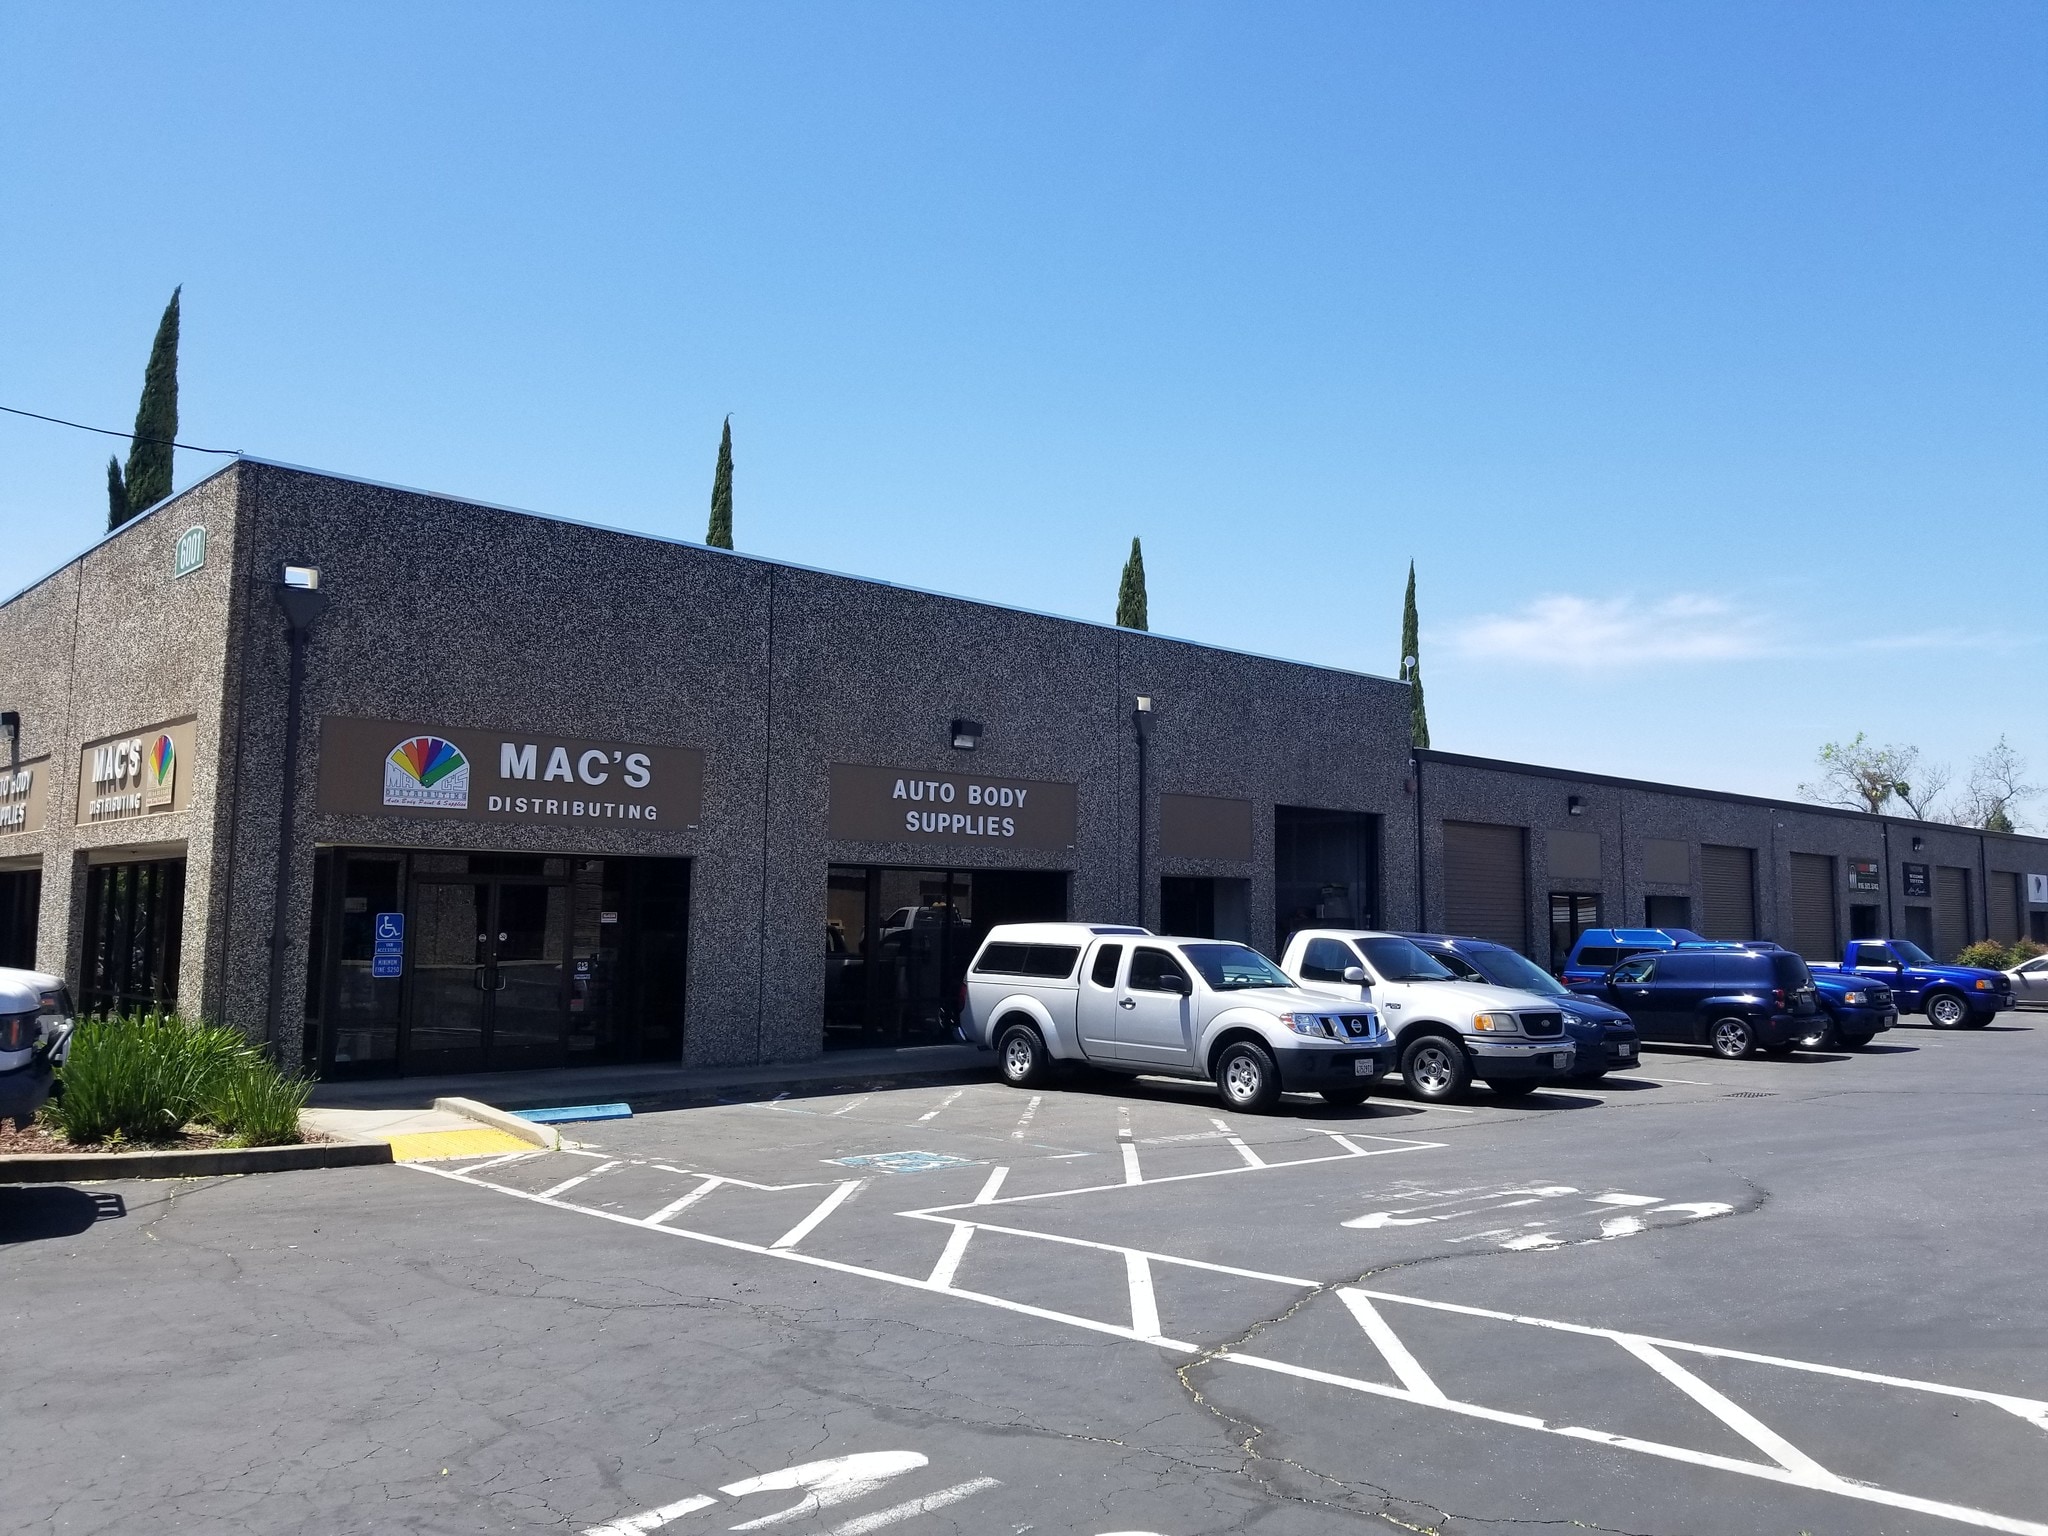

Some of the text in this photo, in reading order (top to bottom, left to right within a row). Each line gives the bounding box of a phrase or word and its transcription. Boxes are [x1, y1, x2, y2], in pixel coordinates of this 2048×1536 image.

[180, 531, 201, 570] 6001
[92, 738, 142, 783] MAC'S
[500, 742, 651, 788] MAC'S
[89, 793, 142, 815] DISTRIBUTING
[488, 796, 658, 821] DISTRIBUTING
[892, 779, 1028, 809] AUTO BODY
[905, 811, 1015, 837] SUPPLIES
